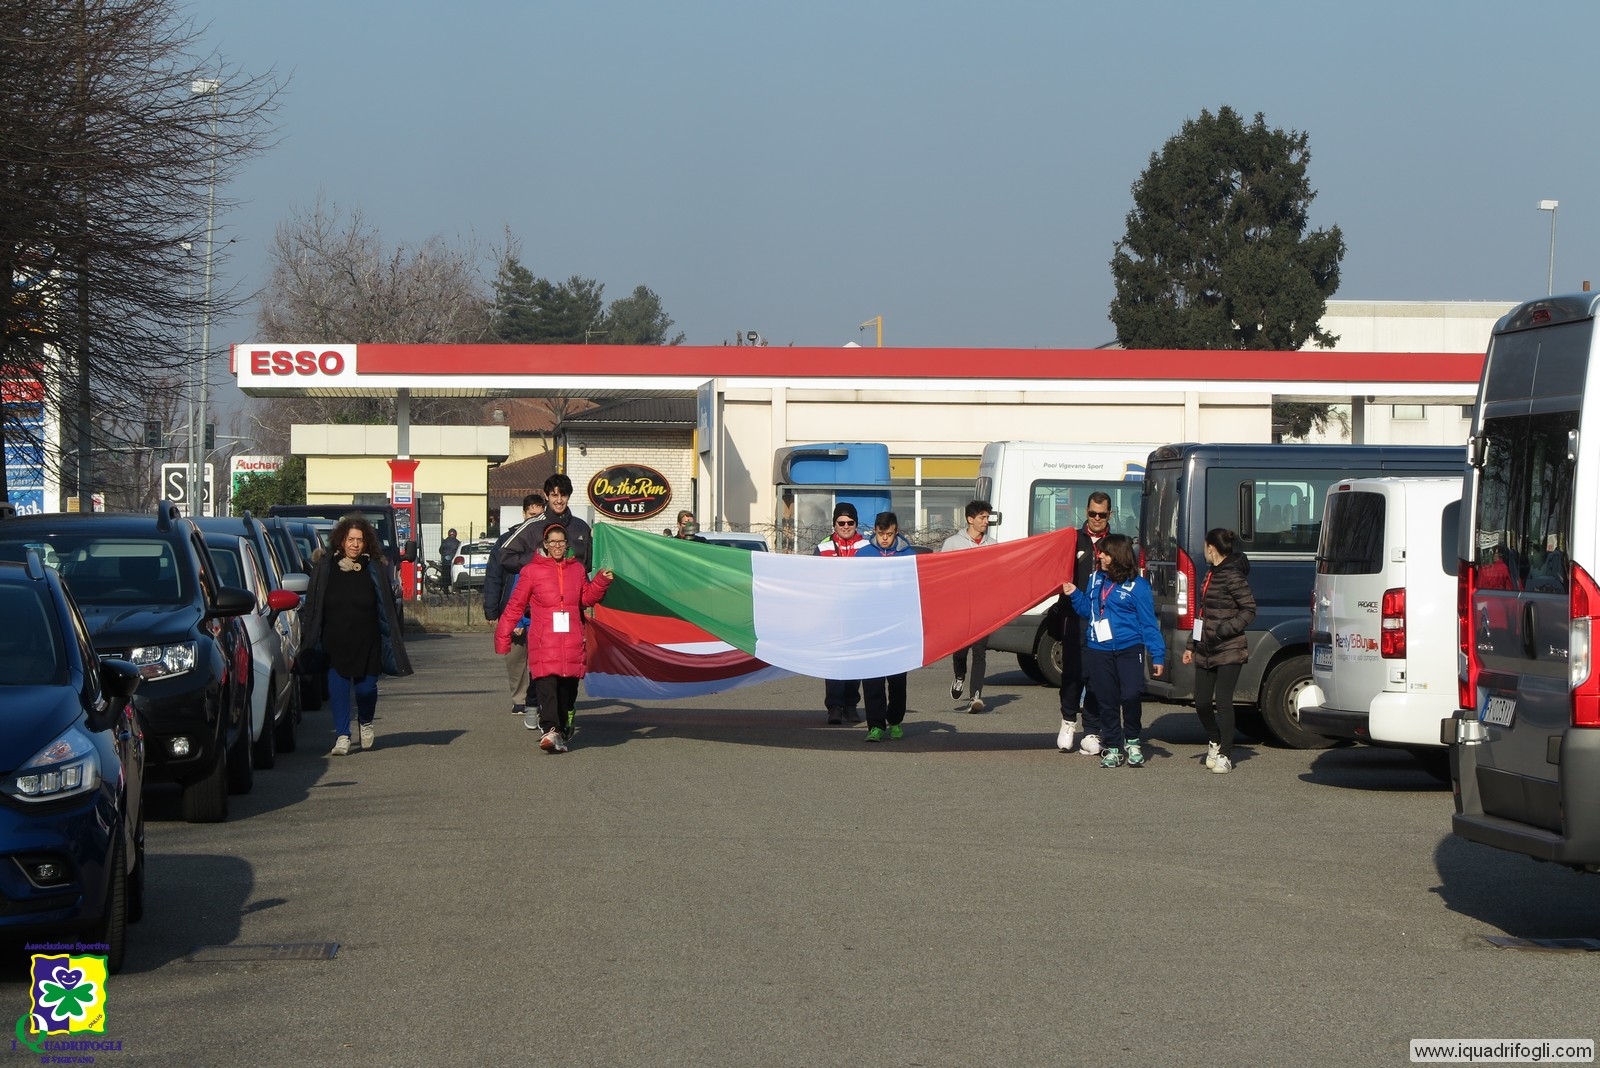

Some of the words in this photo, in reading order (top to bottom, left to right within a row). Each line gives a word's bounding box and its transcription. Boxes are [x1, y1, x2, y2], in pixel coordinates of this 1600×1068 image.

[250, 350, 345, 376] ESSO
[236, 459, 280, 470] Auchan
[1059, 462, 1086, 470] Vigevano
[593, 477, 615, 496] On
[616, 477, 638, 496] the
[635, 477, 667, 498] Run
[613, 501, 646, 513] CAFÉ
